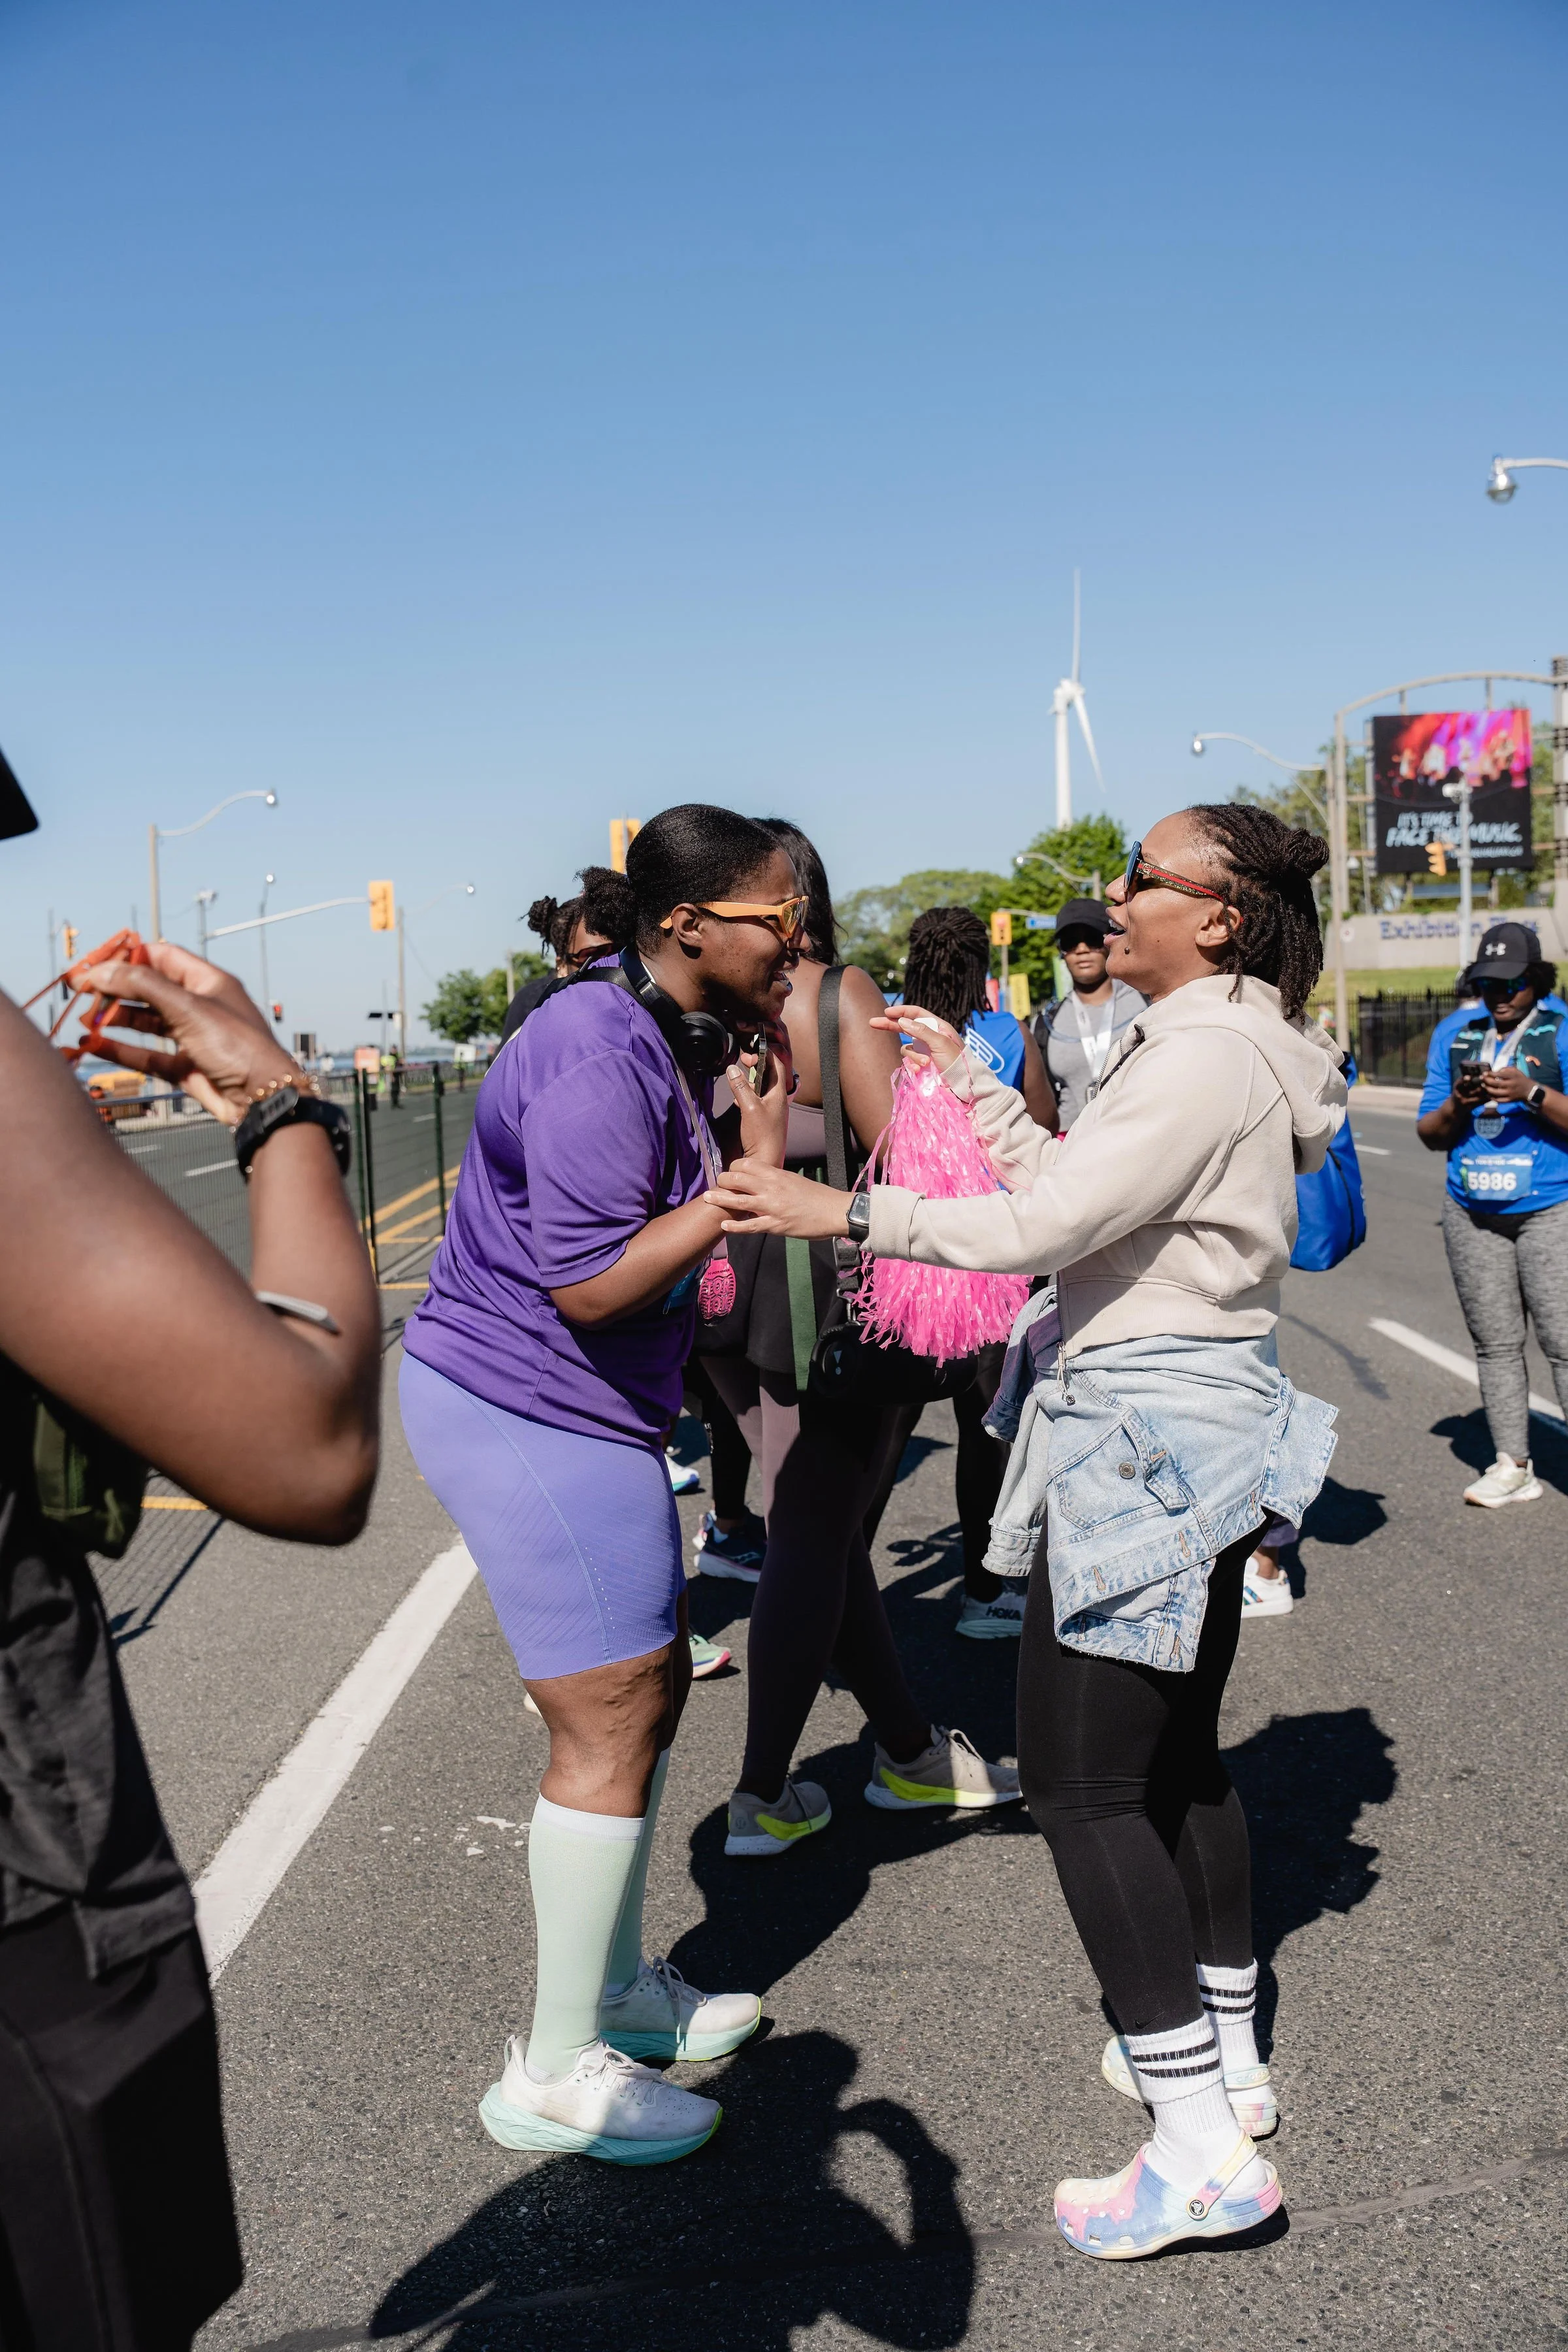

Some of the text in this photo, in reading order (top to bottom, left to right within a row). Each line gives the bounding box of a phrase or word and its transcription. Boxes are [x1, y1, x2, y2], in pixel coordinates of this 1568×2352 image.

[1386, 826, 1429, 847] FACE
[1380, 920, 1483, 939] Exhibitin
[1467, 1171, 1516, 1190] 5986
[705, 1277, 730, 1296] TOR
[985, 1606, 1021, 1621] HOKA
